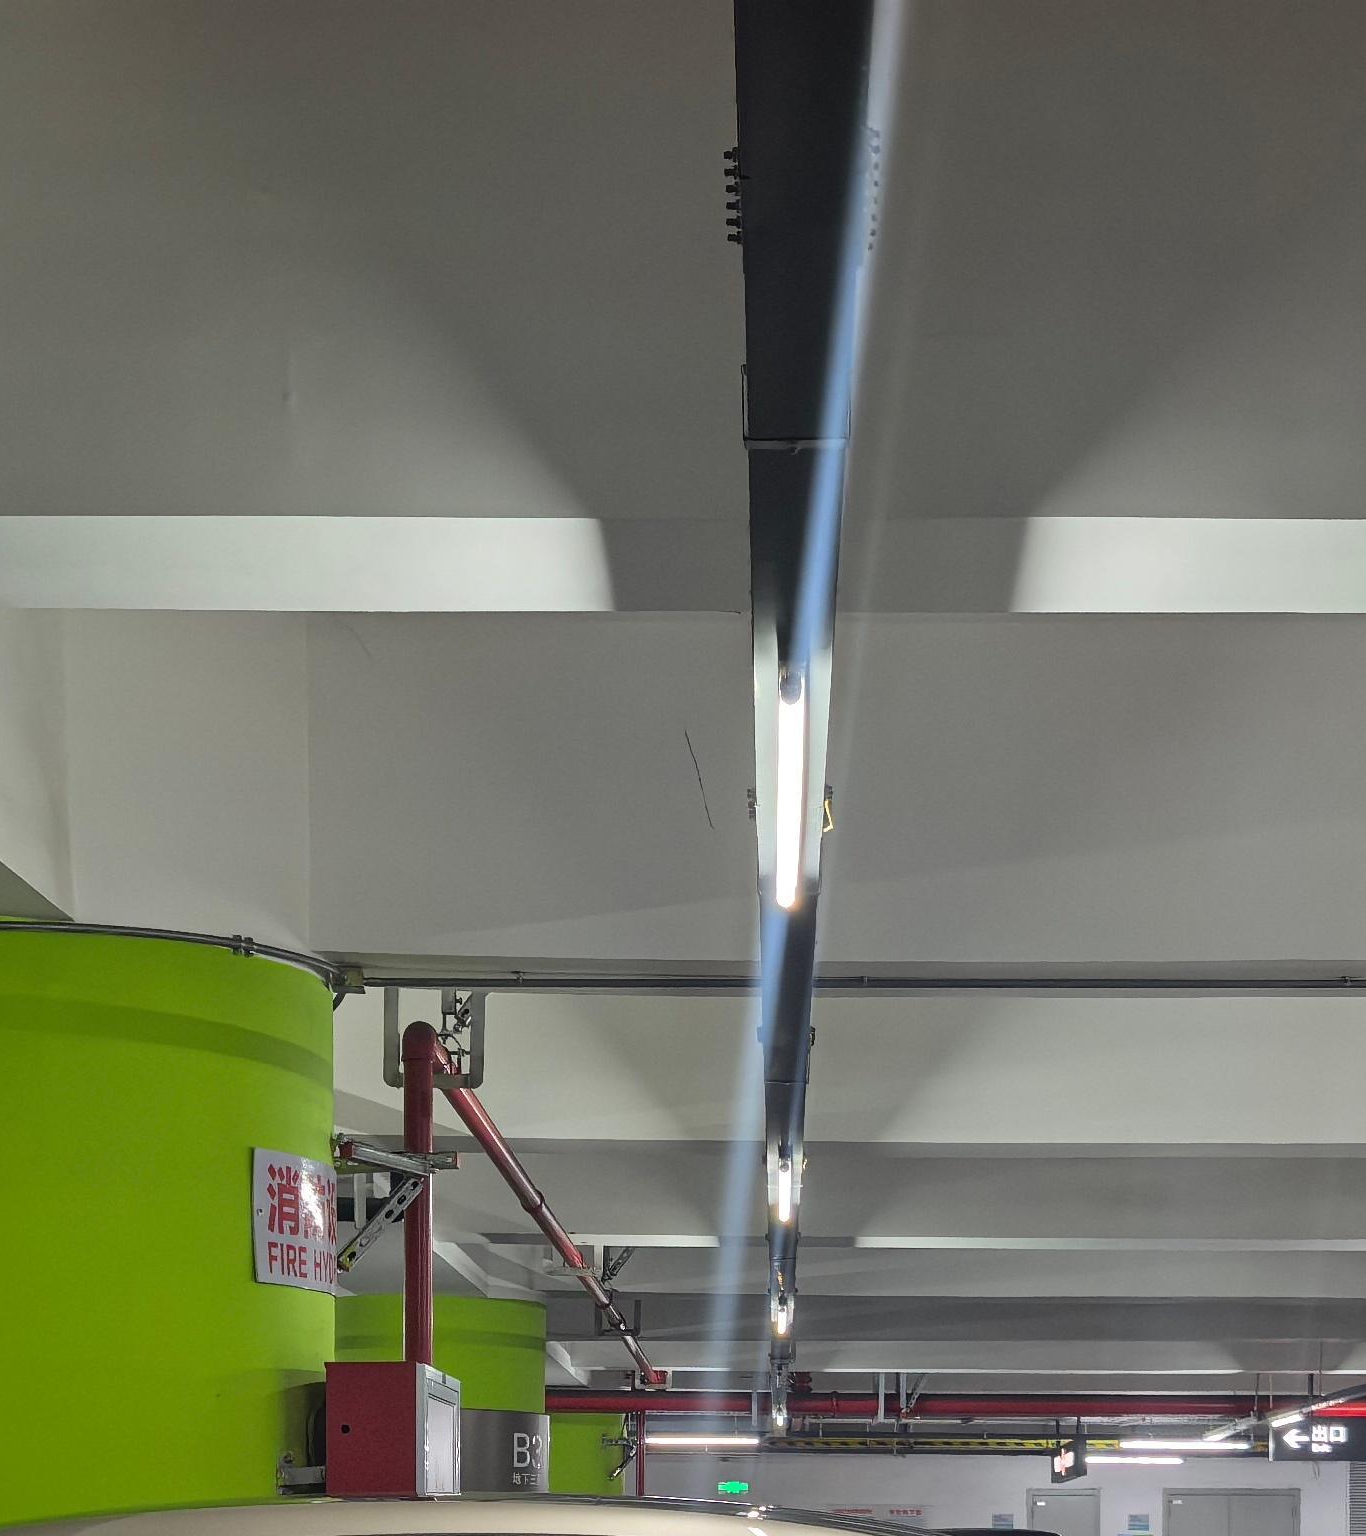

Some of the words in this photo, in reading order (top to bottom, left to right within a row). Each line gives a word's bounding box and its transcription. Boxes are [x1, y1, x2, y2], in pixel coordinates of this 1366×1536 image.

[267, 1241, 308, 1278] FIRE
[513, 1432, 542, 1469] B3
[1311, 1425, 1346, 1443] 出口
